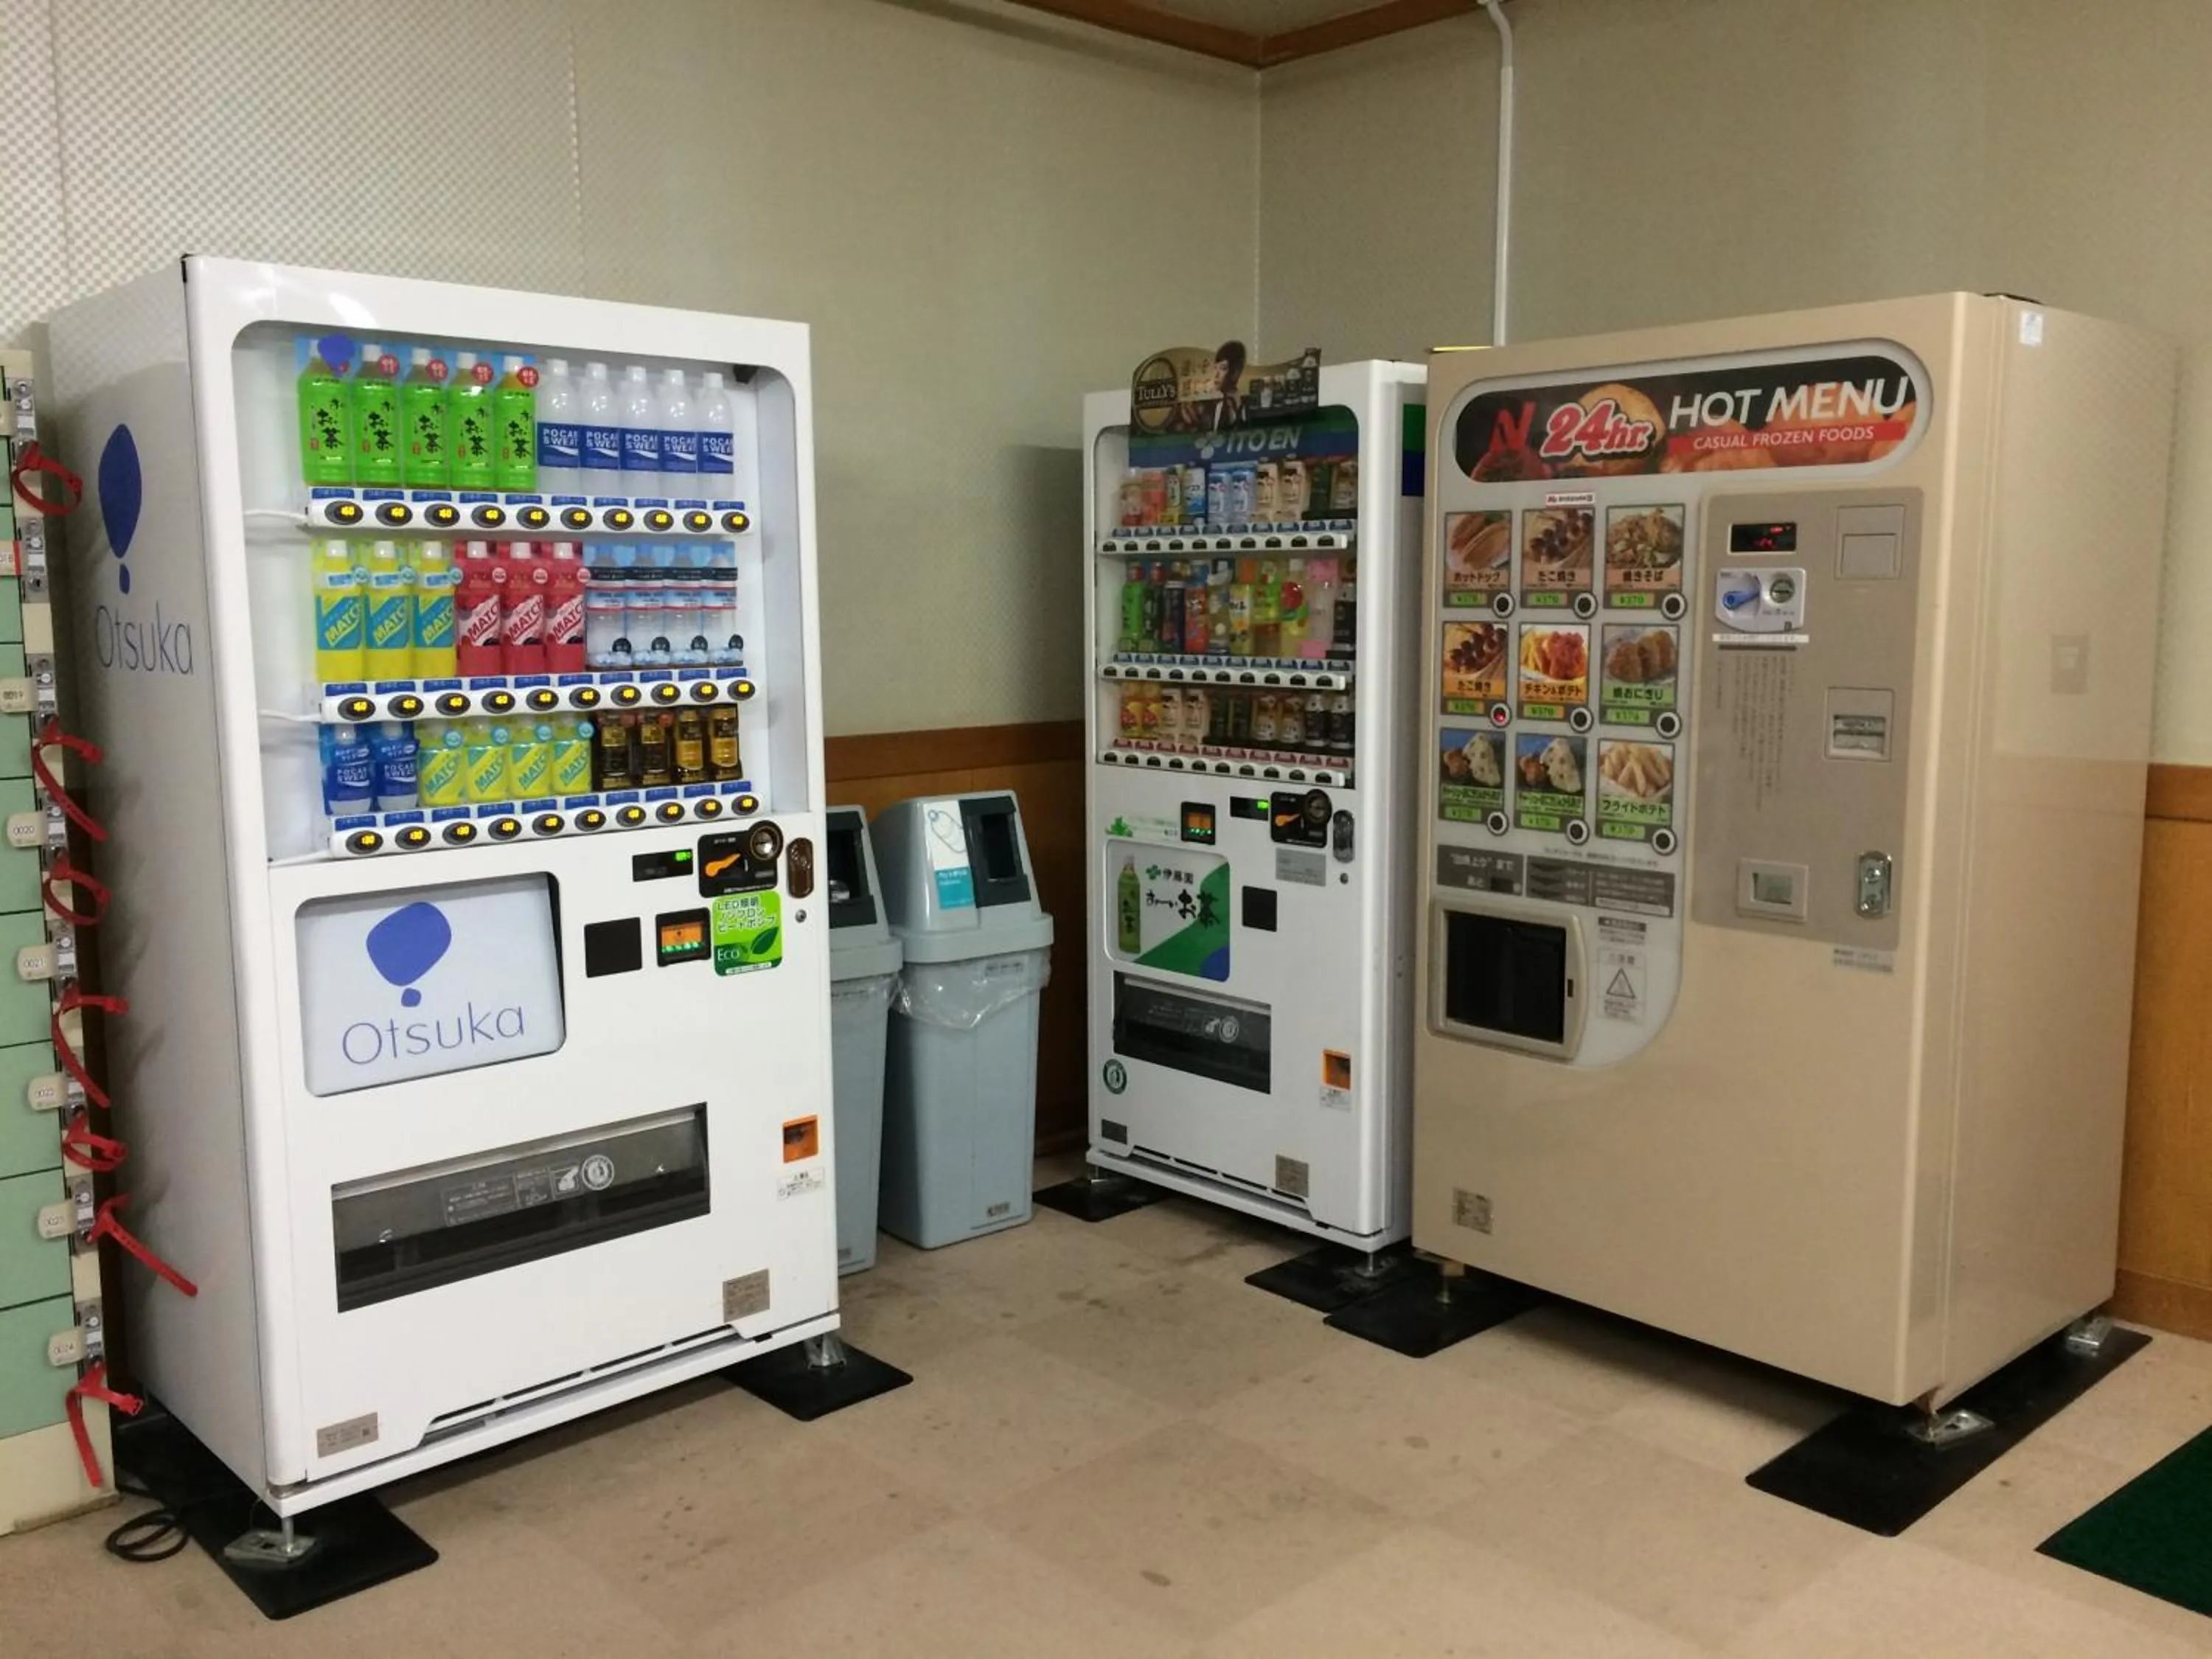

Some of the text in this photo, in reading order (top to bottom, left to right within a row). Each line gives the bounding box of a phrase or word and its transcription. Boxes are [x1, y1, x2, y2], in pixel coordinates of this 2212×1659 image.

[1669, 376, 1908, 428] HOT MENU
[1226, 425, 1302, 453] ITO EN
[1694, 424, 1875, 451] CASUAL FROZEN FOODS
[95, 599, 194, 675] Otsuka
[342, 1001, 524, 1065] Otsuka
